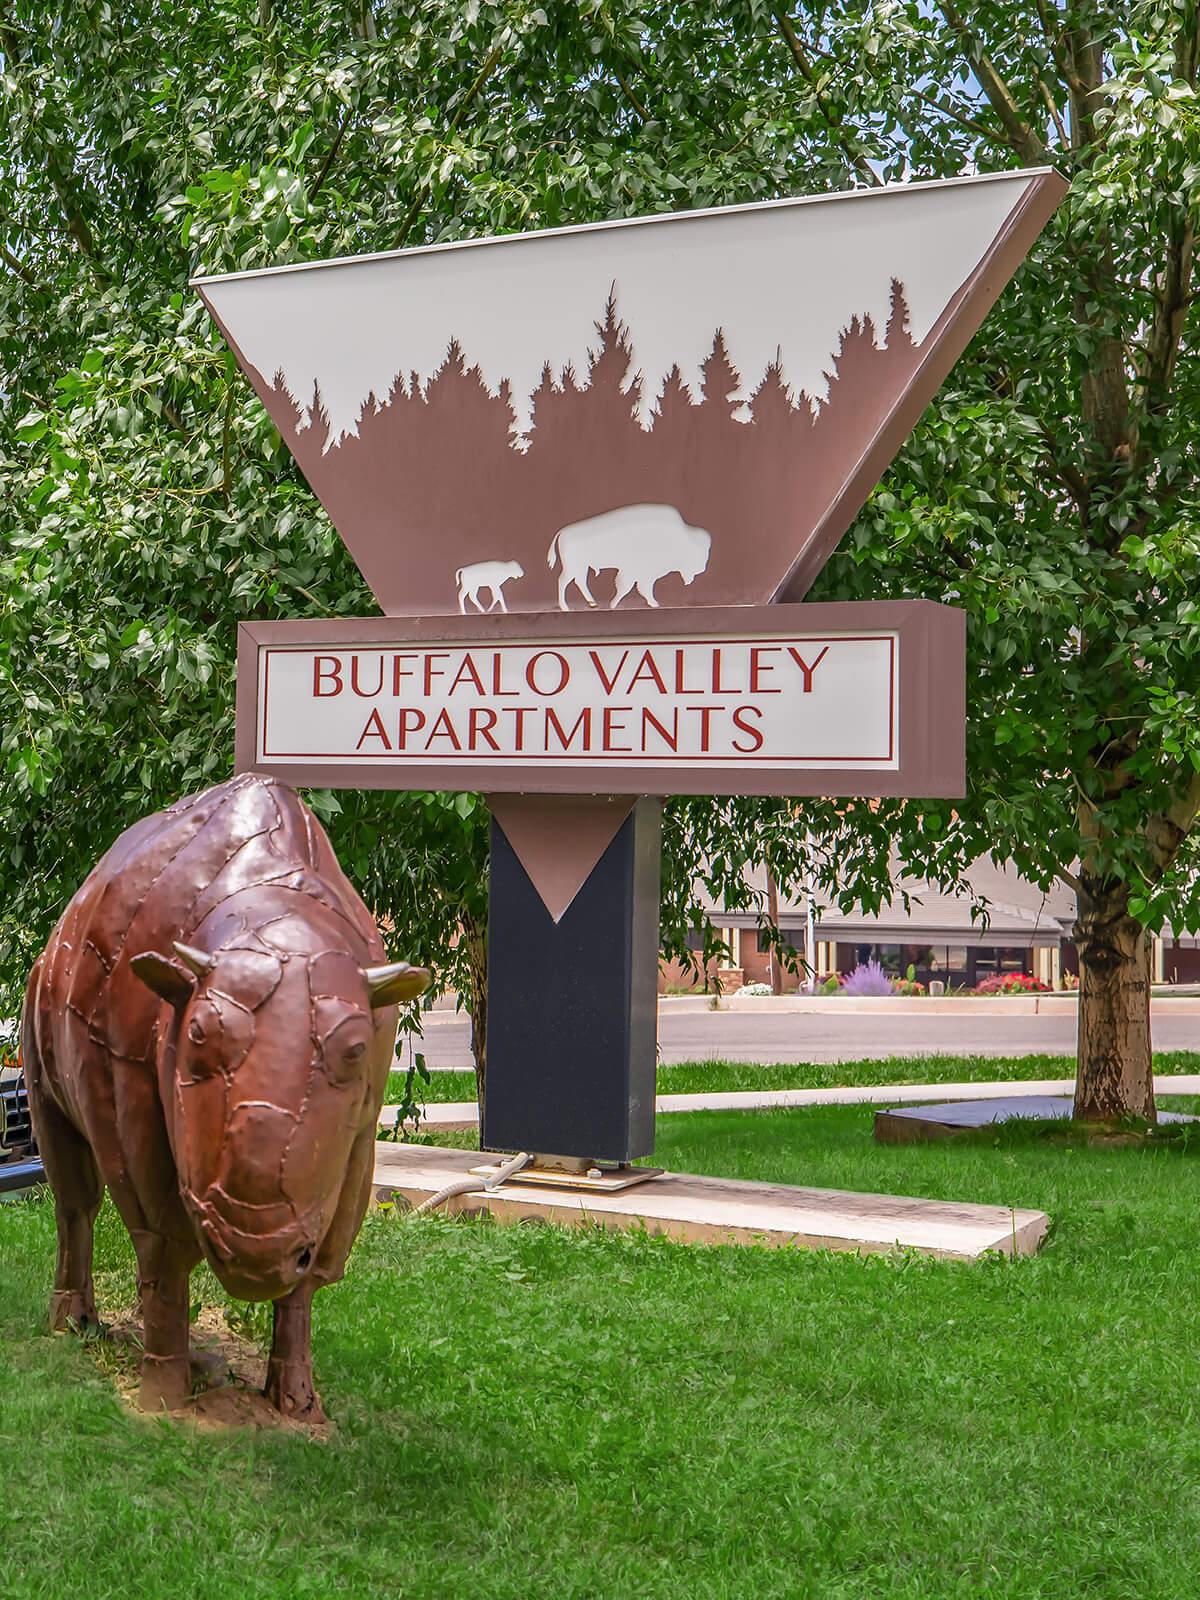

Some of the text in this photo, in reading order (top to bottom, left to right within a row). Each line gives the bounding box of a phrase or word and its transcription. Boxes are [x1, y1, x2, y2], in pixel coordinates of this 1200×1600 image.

[312, 645, 829, 698] BUFFALO VALLEY
[356, 705, 765, 753] APARTMENTS
